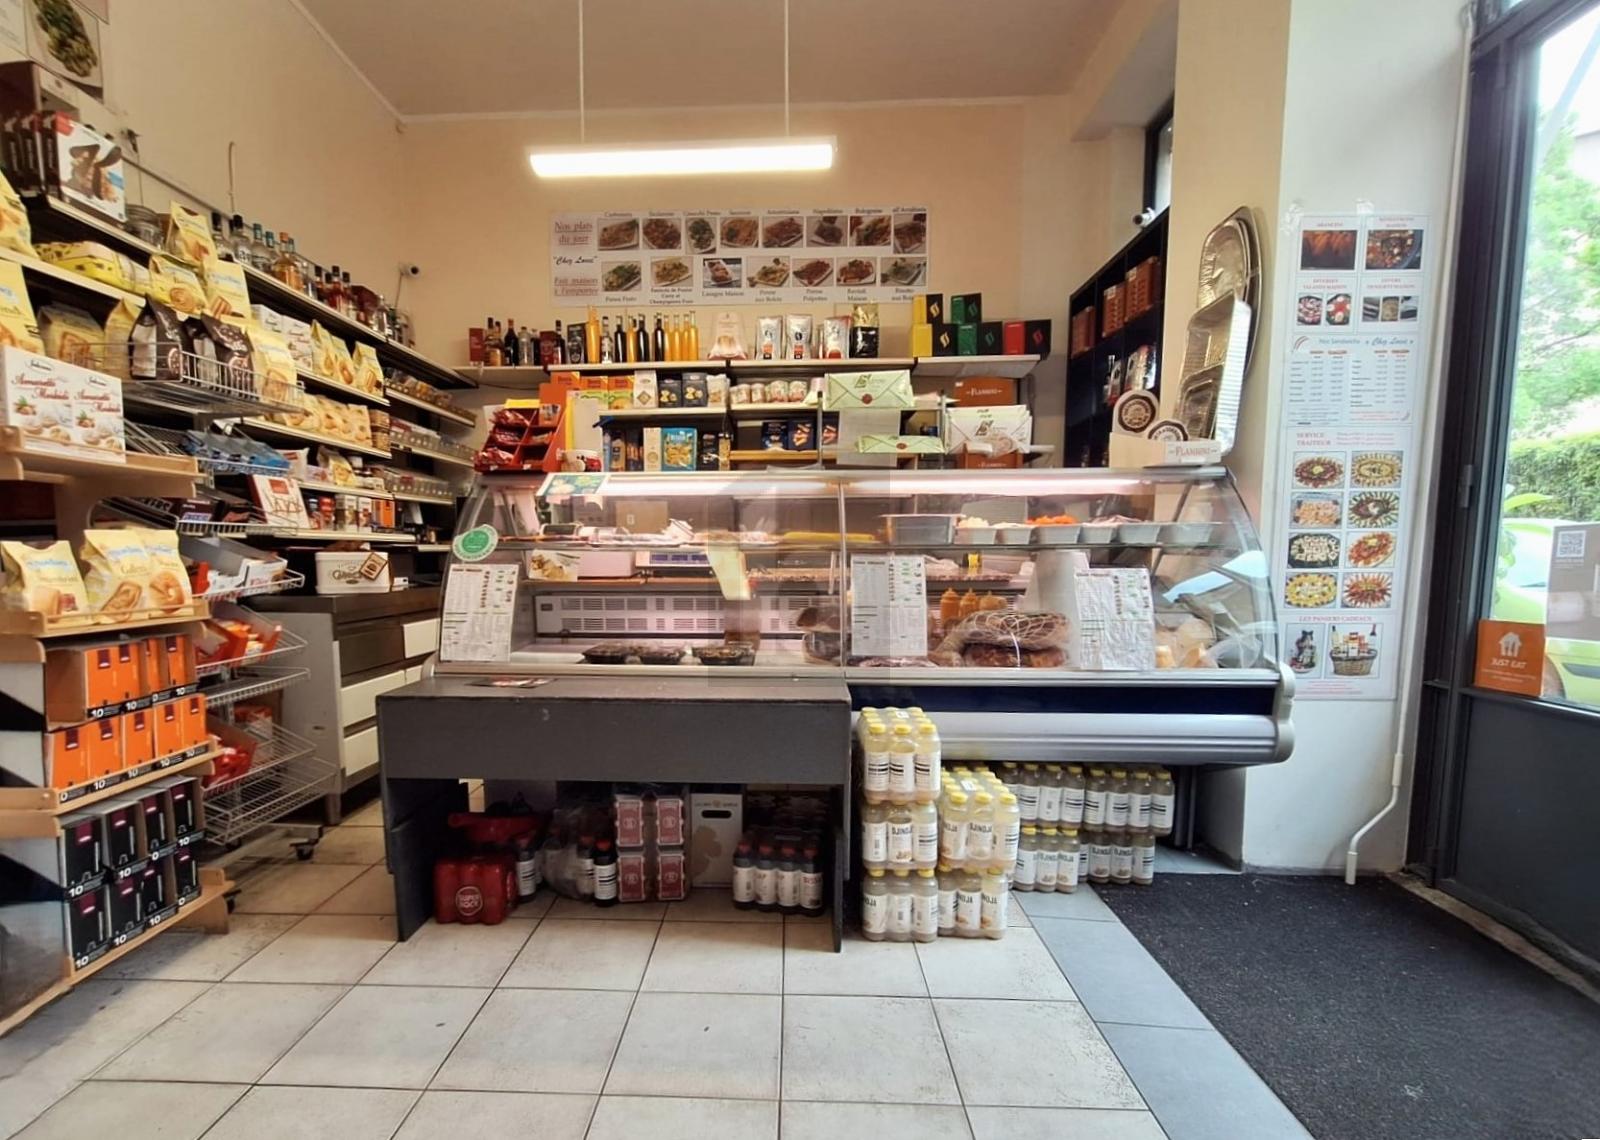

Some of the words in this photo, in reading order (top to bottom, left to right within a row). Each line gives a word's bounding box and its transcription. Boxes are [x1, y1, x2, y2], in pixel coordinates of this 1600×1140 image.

[554, 221, 571, 231] Nos
[574, 220, 592, 233] plats
[559, 235, 570, 243] du
[1491, 657, 1510, 666] JUST
[1511, 660, 1527, 669] EAT
[176, 687, 185, 696] 10
[125, 701, 137, 711] 10
[91, 708, 104, 718] 10
[185, 749, 195, 758] 10
[160, 758, 170, 767] 10
[127, 768, 139, 778] 10
[94, 780, 106, 789] 10
[178, 836, 190, 846] 10
[118, 867, 132, 878] 10
[68, 885, 84, 897] 10
[149, 915, 161, 926] 10
[113, 934, 127, 946] 10
[75, 955, 89, 968] 10
